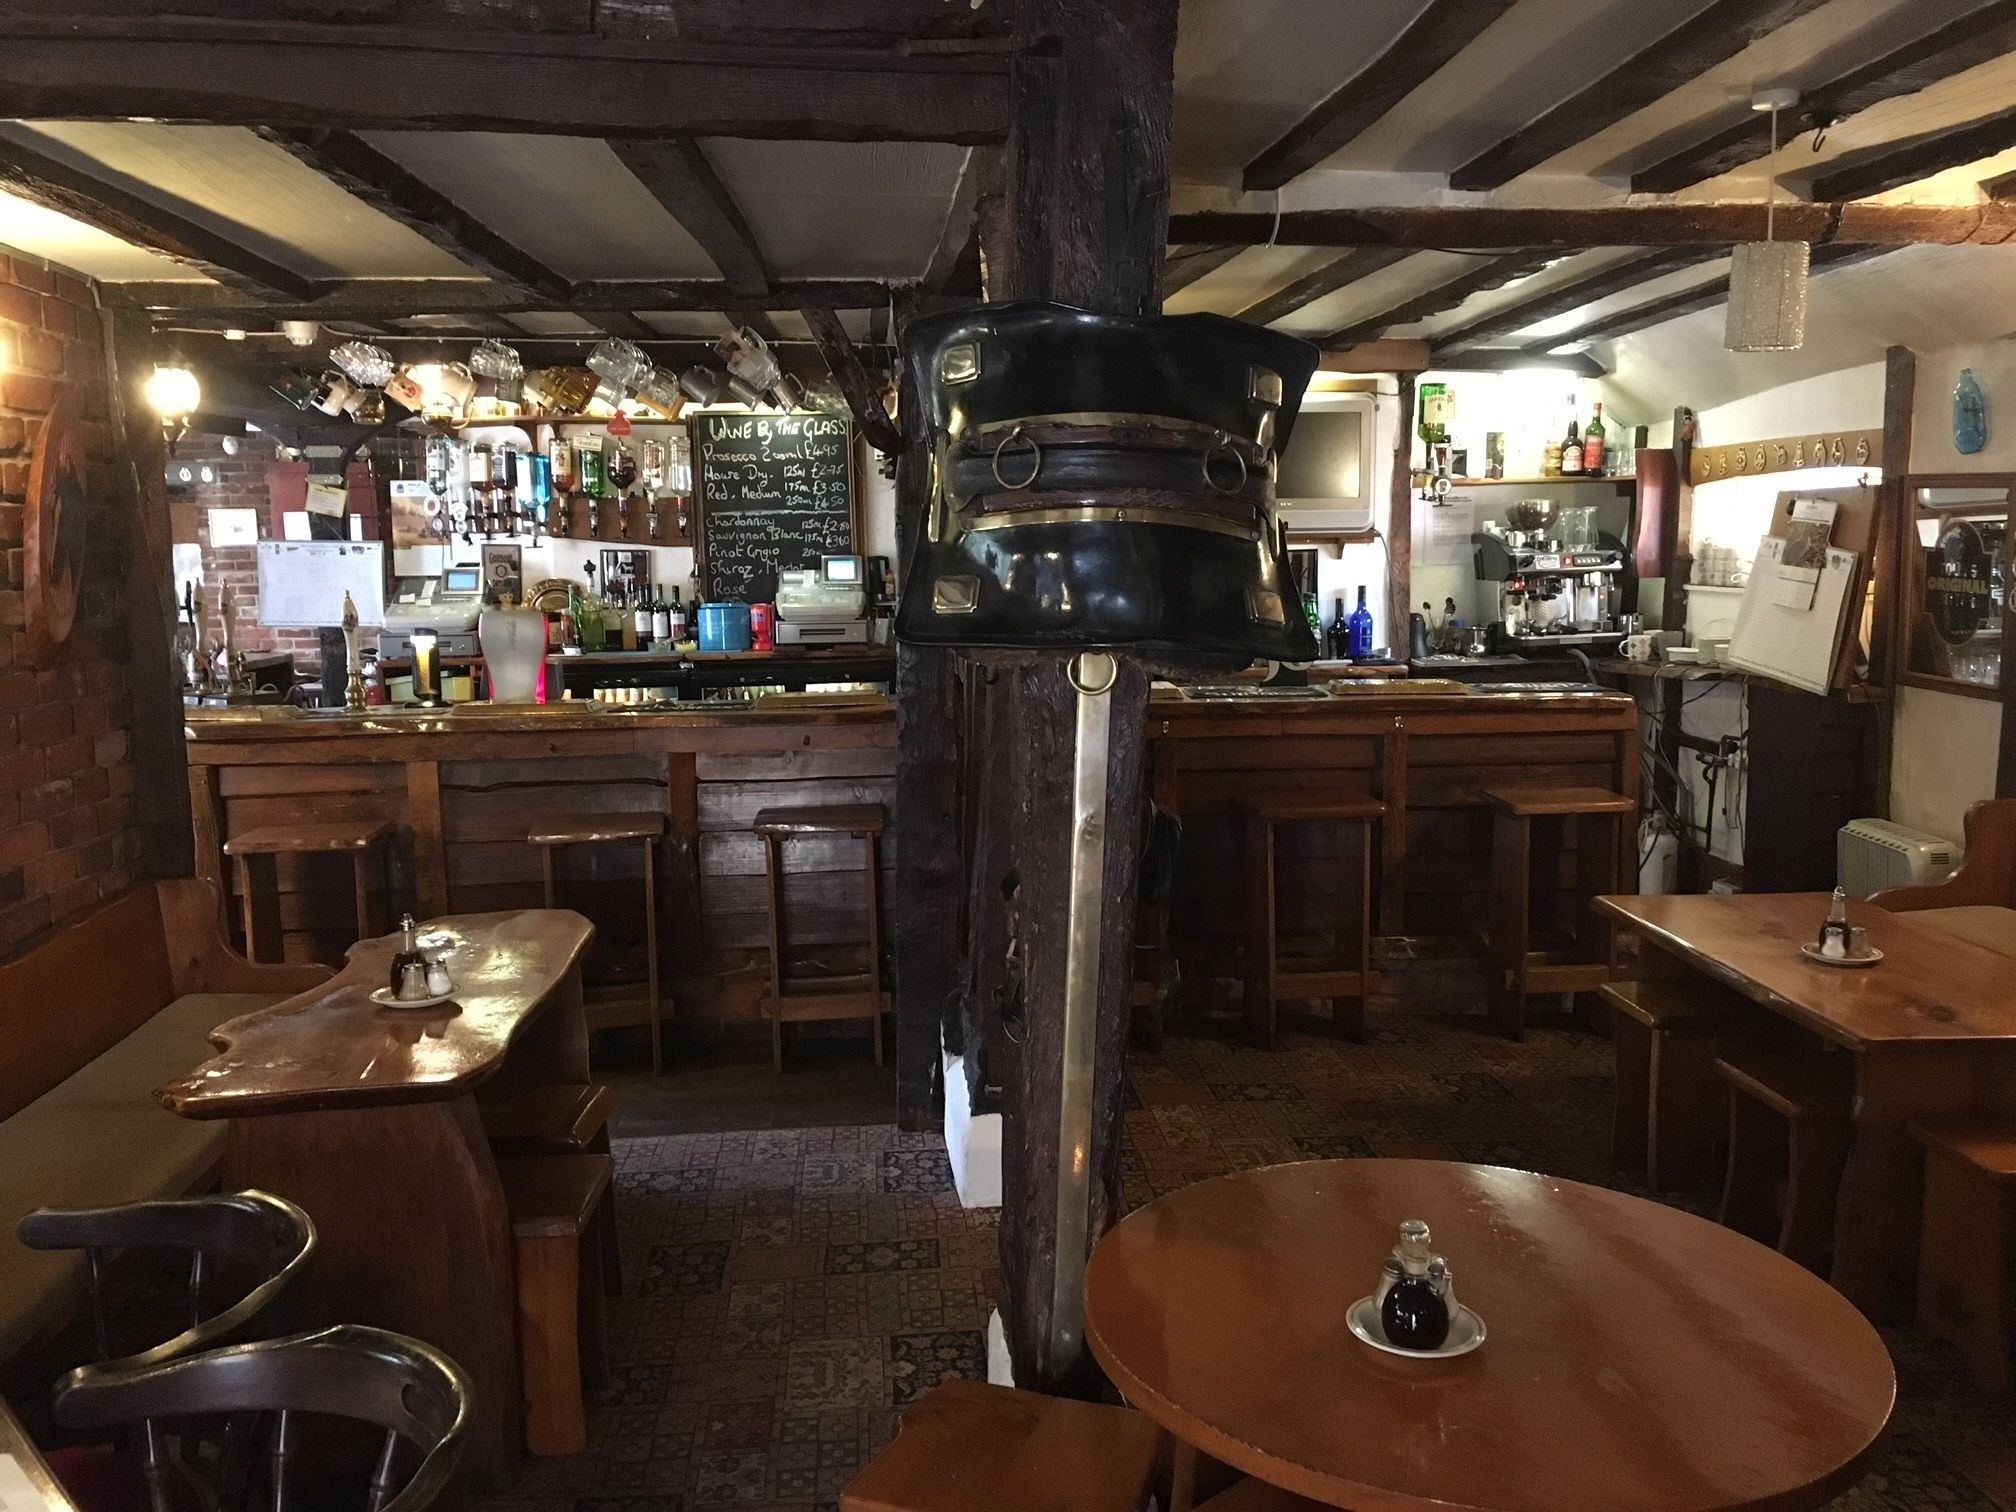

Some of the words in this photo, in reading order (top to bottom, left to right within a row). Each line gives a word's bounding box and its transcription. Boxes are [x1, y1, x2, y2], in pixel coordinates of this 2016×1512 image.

[775, 415, 801, 436] THE
[803, 417, 846, 441] GLASS
[702, 443, 757, 462] Prosecco
[704, 464, 740, 482] House
[741, 484, 782, 500] Medium
[706, 516, 775, 532] Chardonnay
[707, 529, 767, 545] Sauvignon
[770, 527, 804, 542] Blanc
[709, 543, 744, 558] Pinot
[747, 545, 780, 562] Grigio
[1927, 576, 1989, 595] ORIGINAL
